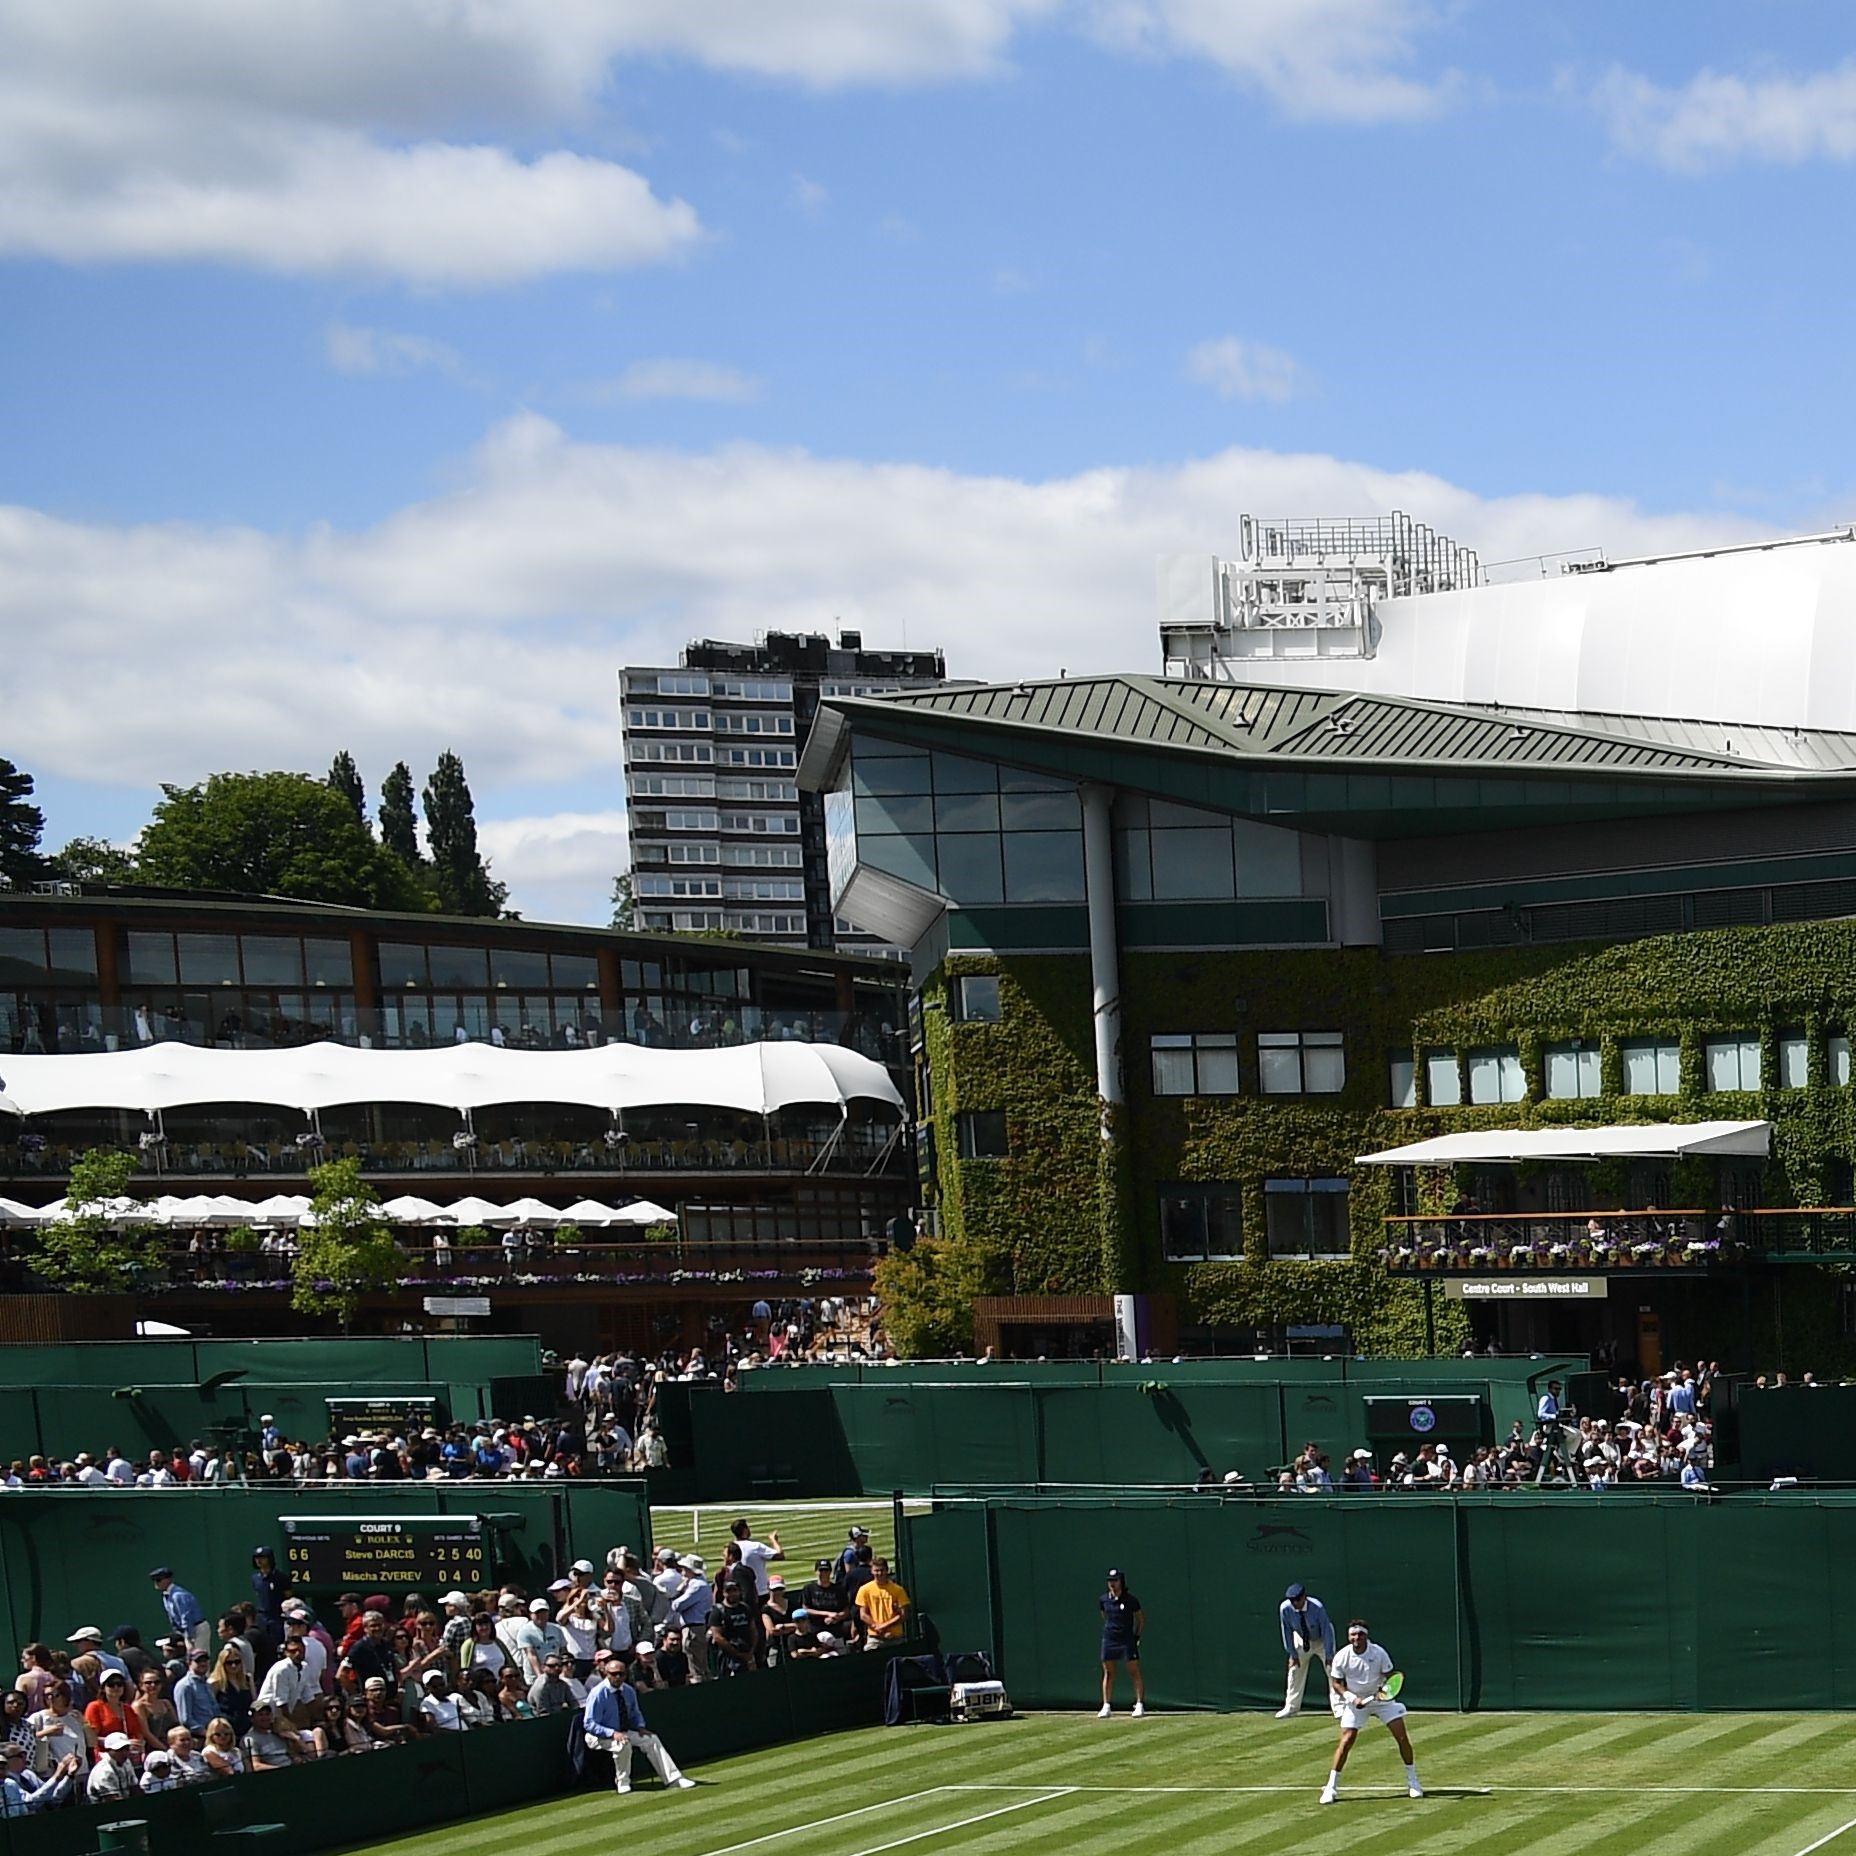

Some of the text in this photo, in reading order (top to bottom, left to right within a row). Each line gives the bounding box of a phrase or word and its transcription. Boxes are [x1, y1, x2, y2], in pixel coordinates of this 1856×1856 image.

[1462, 1282, 1588, 1294] Centre Court South West Hall
[360, 1525, 401, 1533] COURT 9
[367, 1536, 401, 1544] ROLEX
[289, 1549, 482, 1560] 6 6 Steve DARCIS 2 5 40
[291, 1571, 479, 1582] 2 4 Mischa ZVEREV 0 4 0
